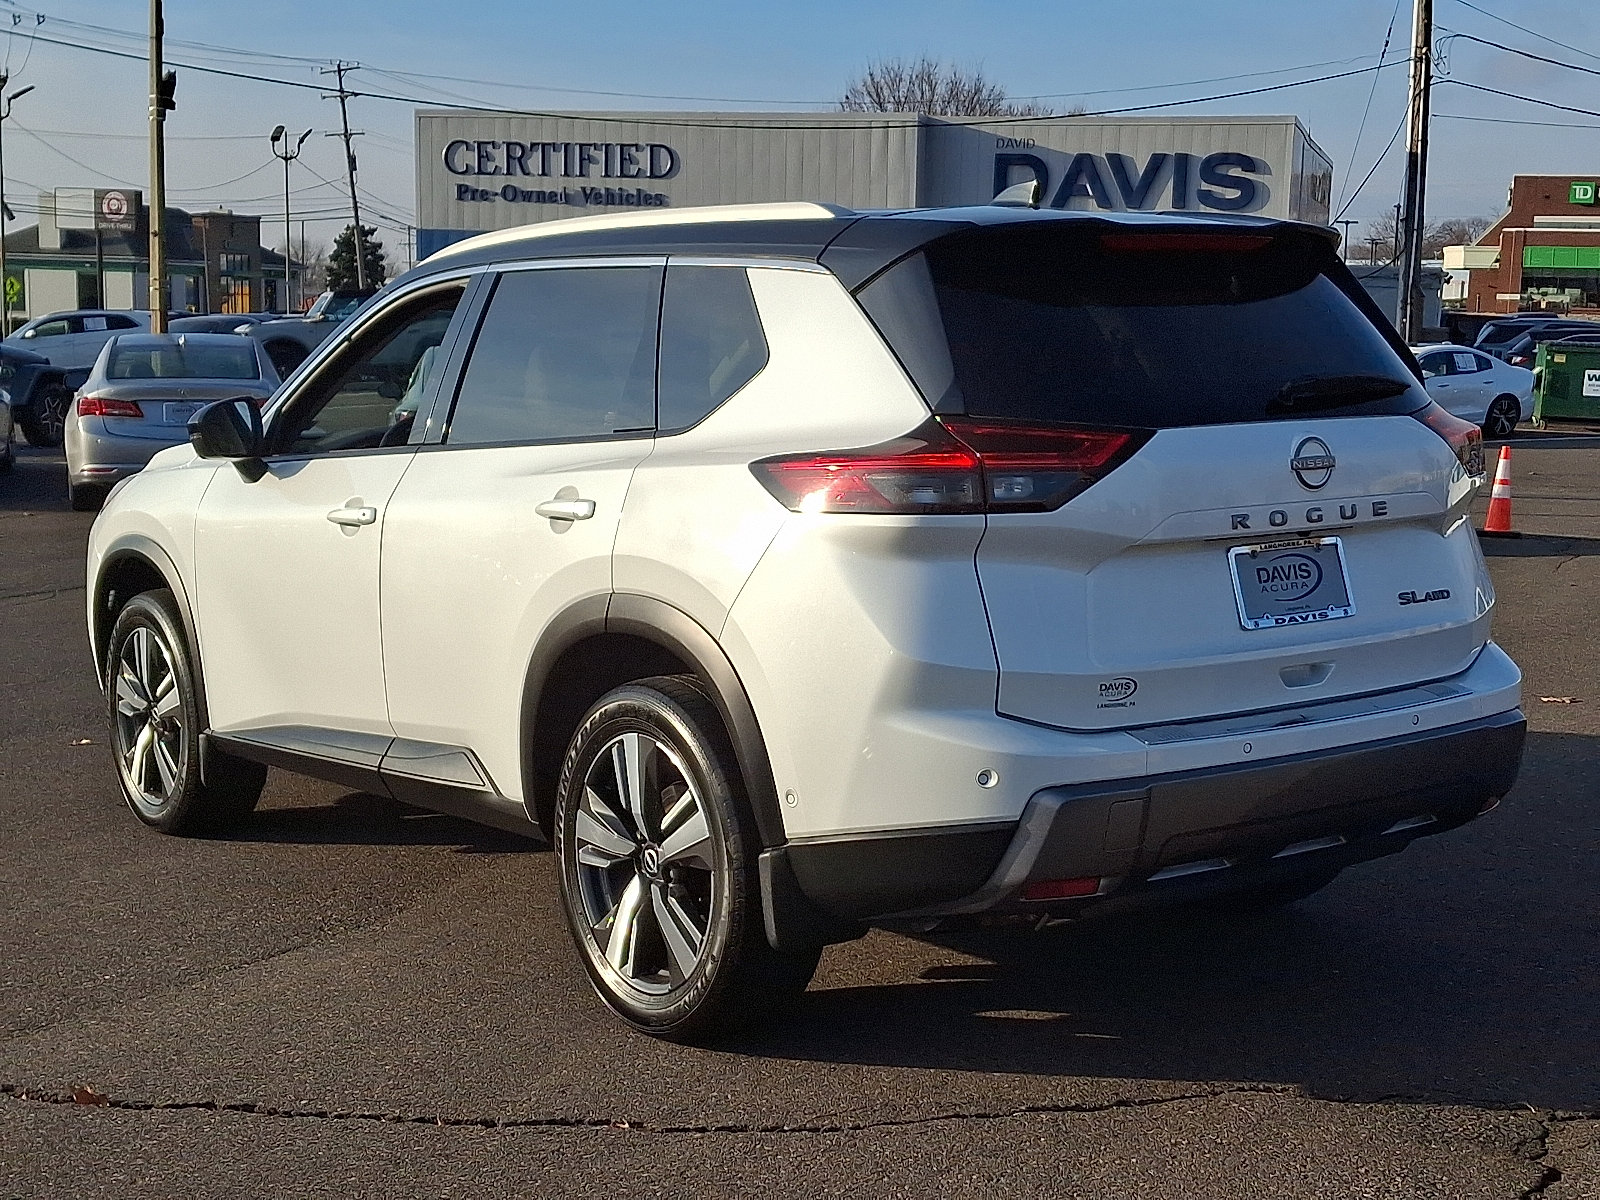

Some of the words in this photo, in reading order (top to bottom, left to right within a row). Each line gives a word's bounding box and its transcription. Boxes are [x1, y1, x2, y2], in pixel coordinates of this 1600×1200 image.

[996, 138, 1036, 149] DAVID
[443, 140, 677, 179] CERTIFIED
[993, 153, 1257, 211] DAVIS
[455, 184, 567, 206] Pre-Owned
[580, 187, 667, 206] Vehicles
[1572, 185, 1592, 199] TD
[1292, 459, 1335, 469] NISSAN
[1231, 501, 1388, 530] ROGUE
[1256, 563, 1312, 584] DAVIS
[1261, 582, 1309, 593] ACURA
[1274, 612, 1329, 625] DAVIS
[1099, 682, 1131, 691] DAVIS
